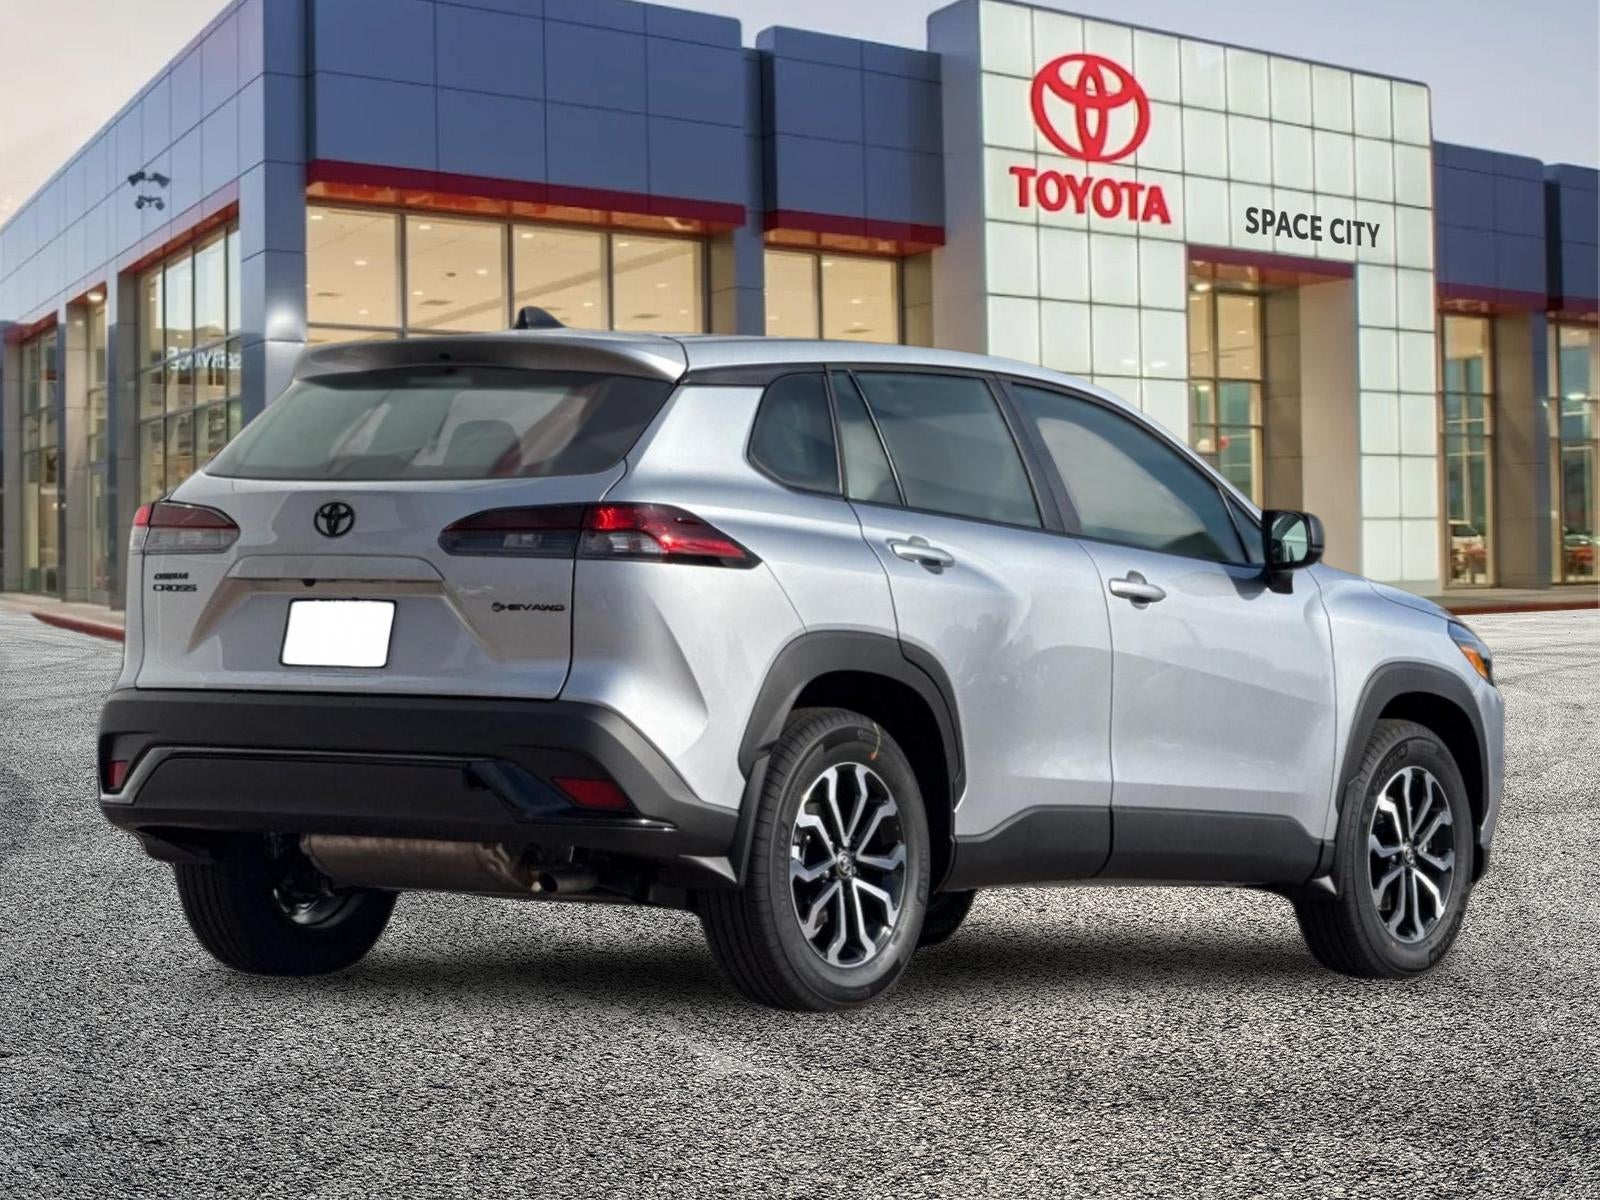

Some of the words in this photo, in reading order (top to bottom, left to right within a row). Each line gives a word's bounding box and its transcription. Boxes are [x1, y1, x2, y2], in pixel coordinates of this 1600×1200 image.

[1008, 166, 1172, 225] TOYOTA
[1245, 206, 1323, 242] SPACE
[1329, 218, 1381, 248] CITY
[153, 584, 197, 592] CROSS
